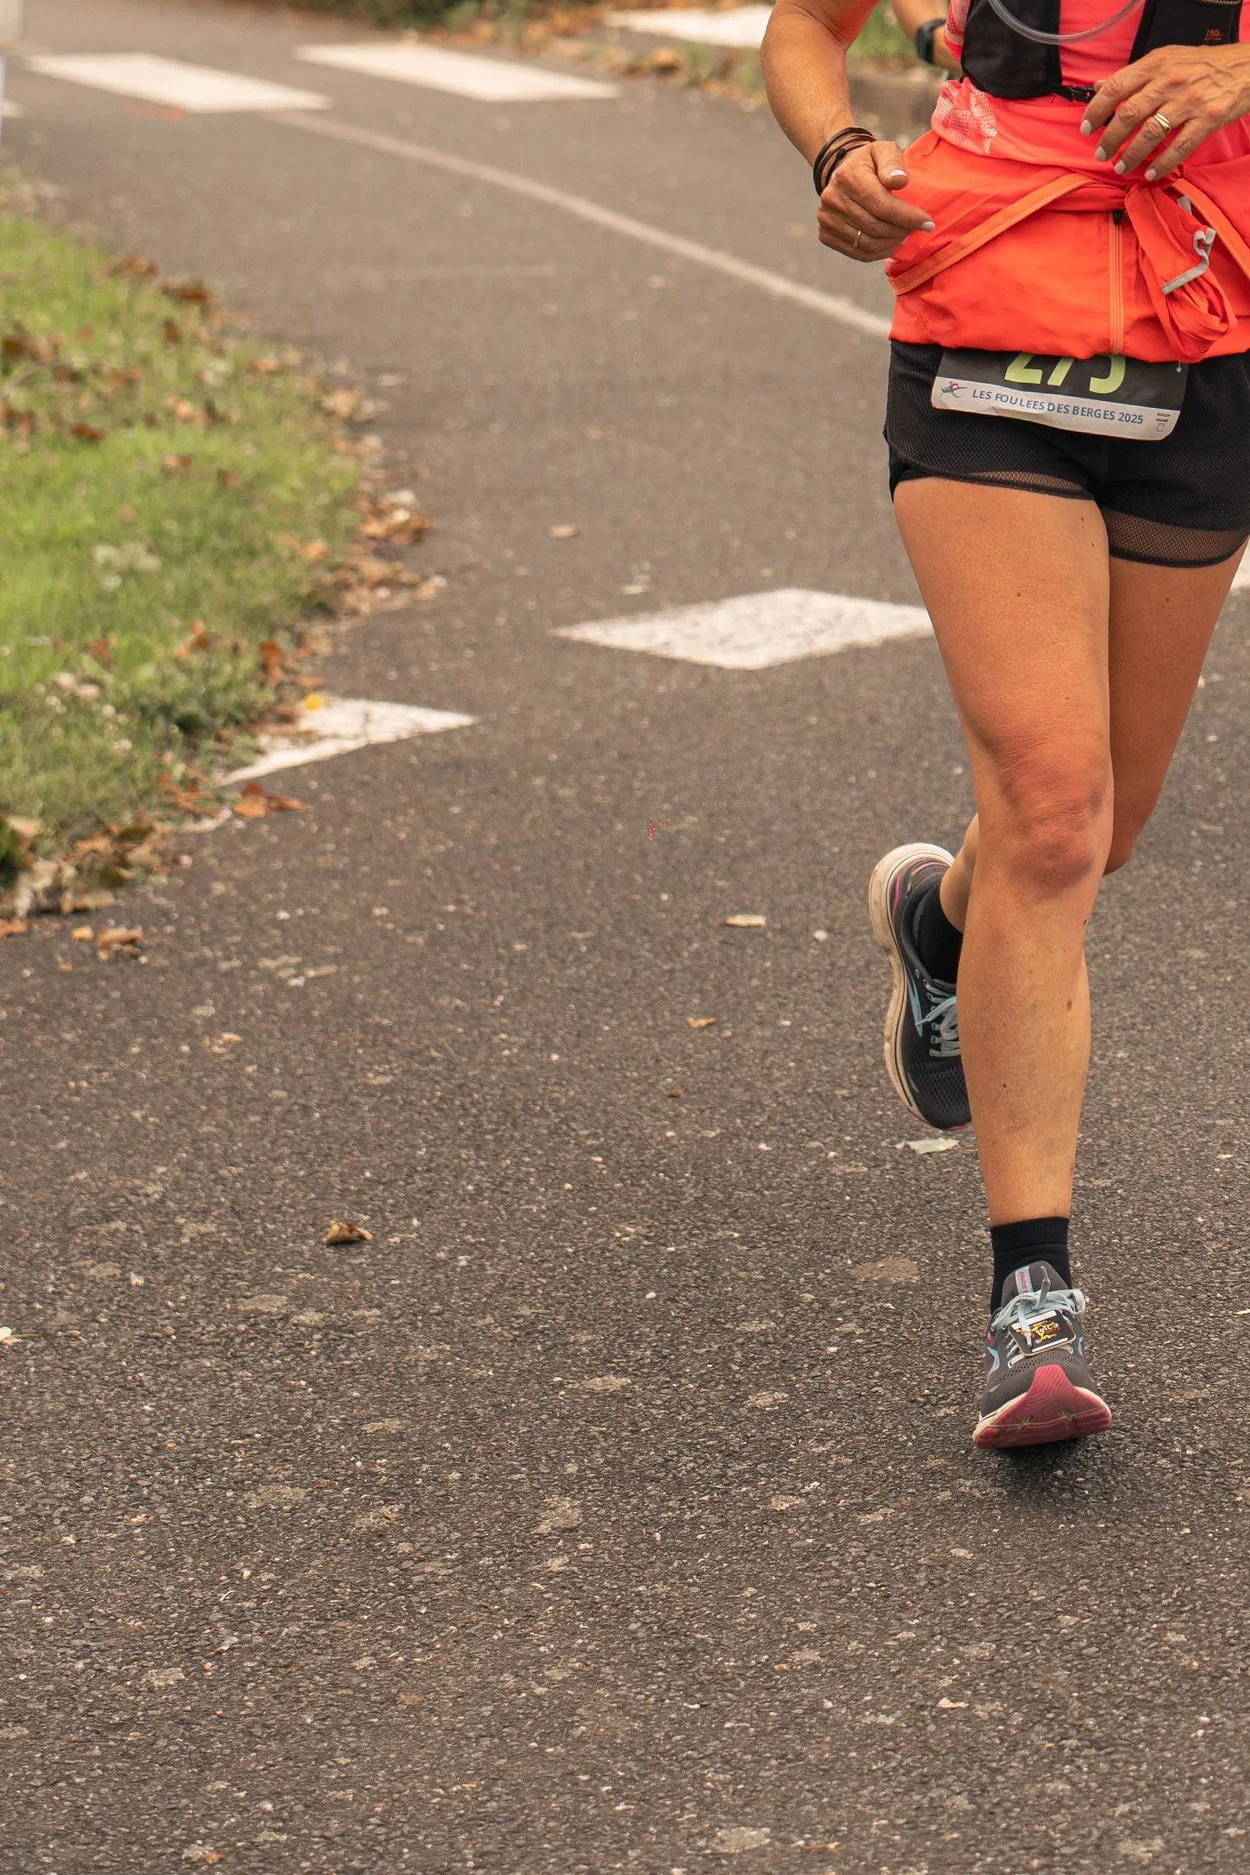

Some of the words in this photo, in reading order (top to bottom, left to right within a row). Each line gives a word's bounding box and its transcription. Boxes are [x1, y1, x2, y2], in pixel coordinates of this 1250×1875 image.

[972, 389, 992, 400] LES
[995, 393, 1045, 410] FOULEES
[1047, 402, 1070, 414] DES
[1072, 406, 1116, 421] BERGES
[1118, 412, 1144, 425] 2025
